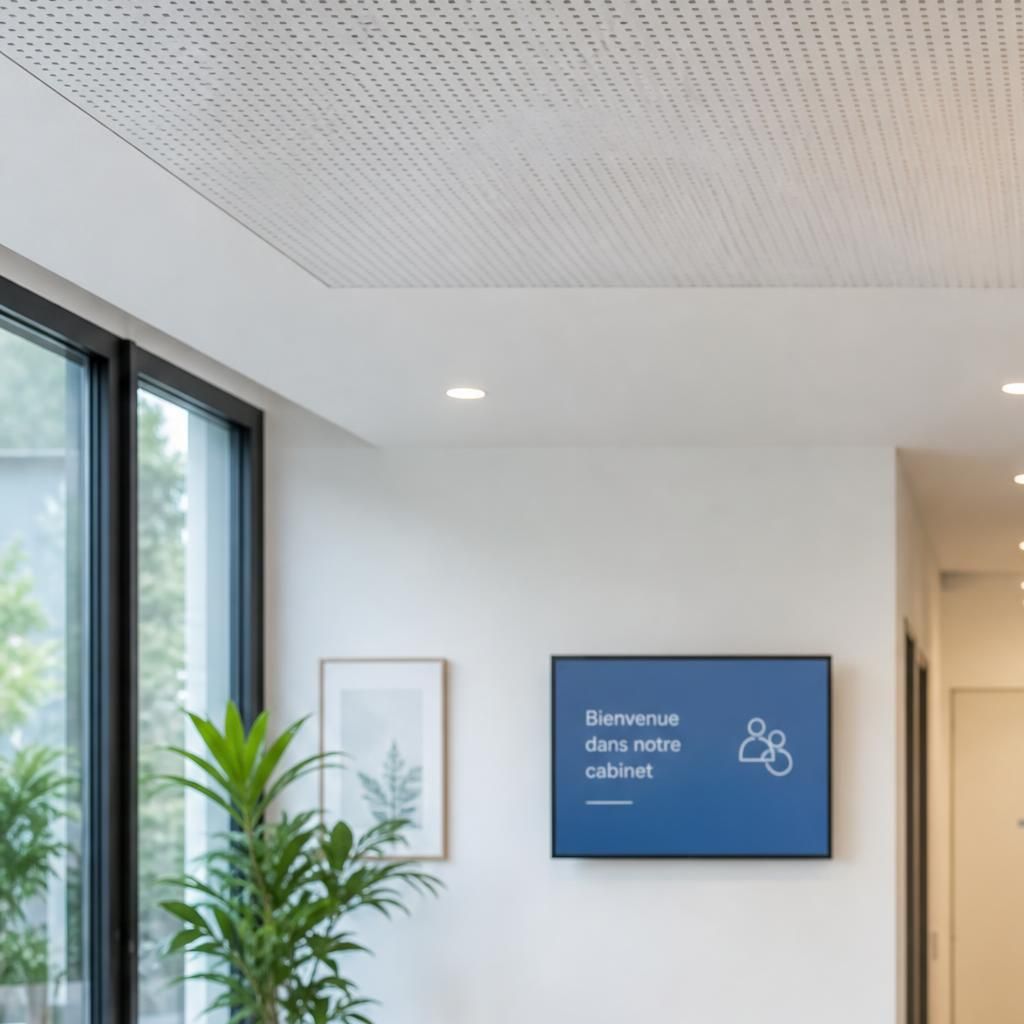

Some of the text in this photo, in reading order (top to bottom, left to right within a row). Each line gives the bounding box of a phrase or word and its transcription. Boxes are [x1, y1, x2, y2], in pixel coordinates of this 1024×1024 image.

[586, 710, 679, 726] Bienvenue
[585, 736, 681, 752] dans notre
[585, 762, 653, 779] cabinet
